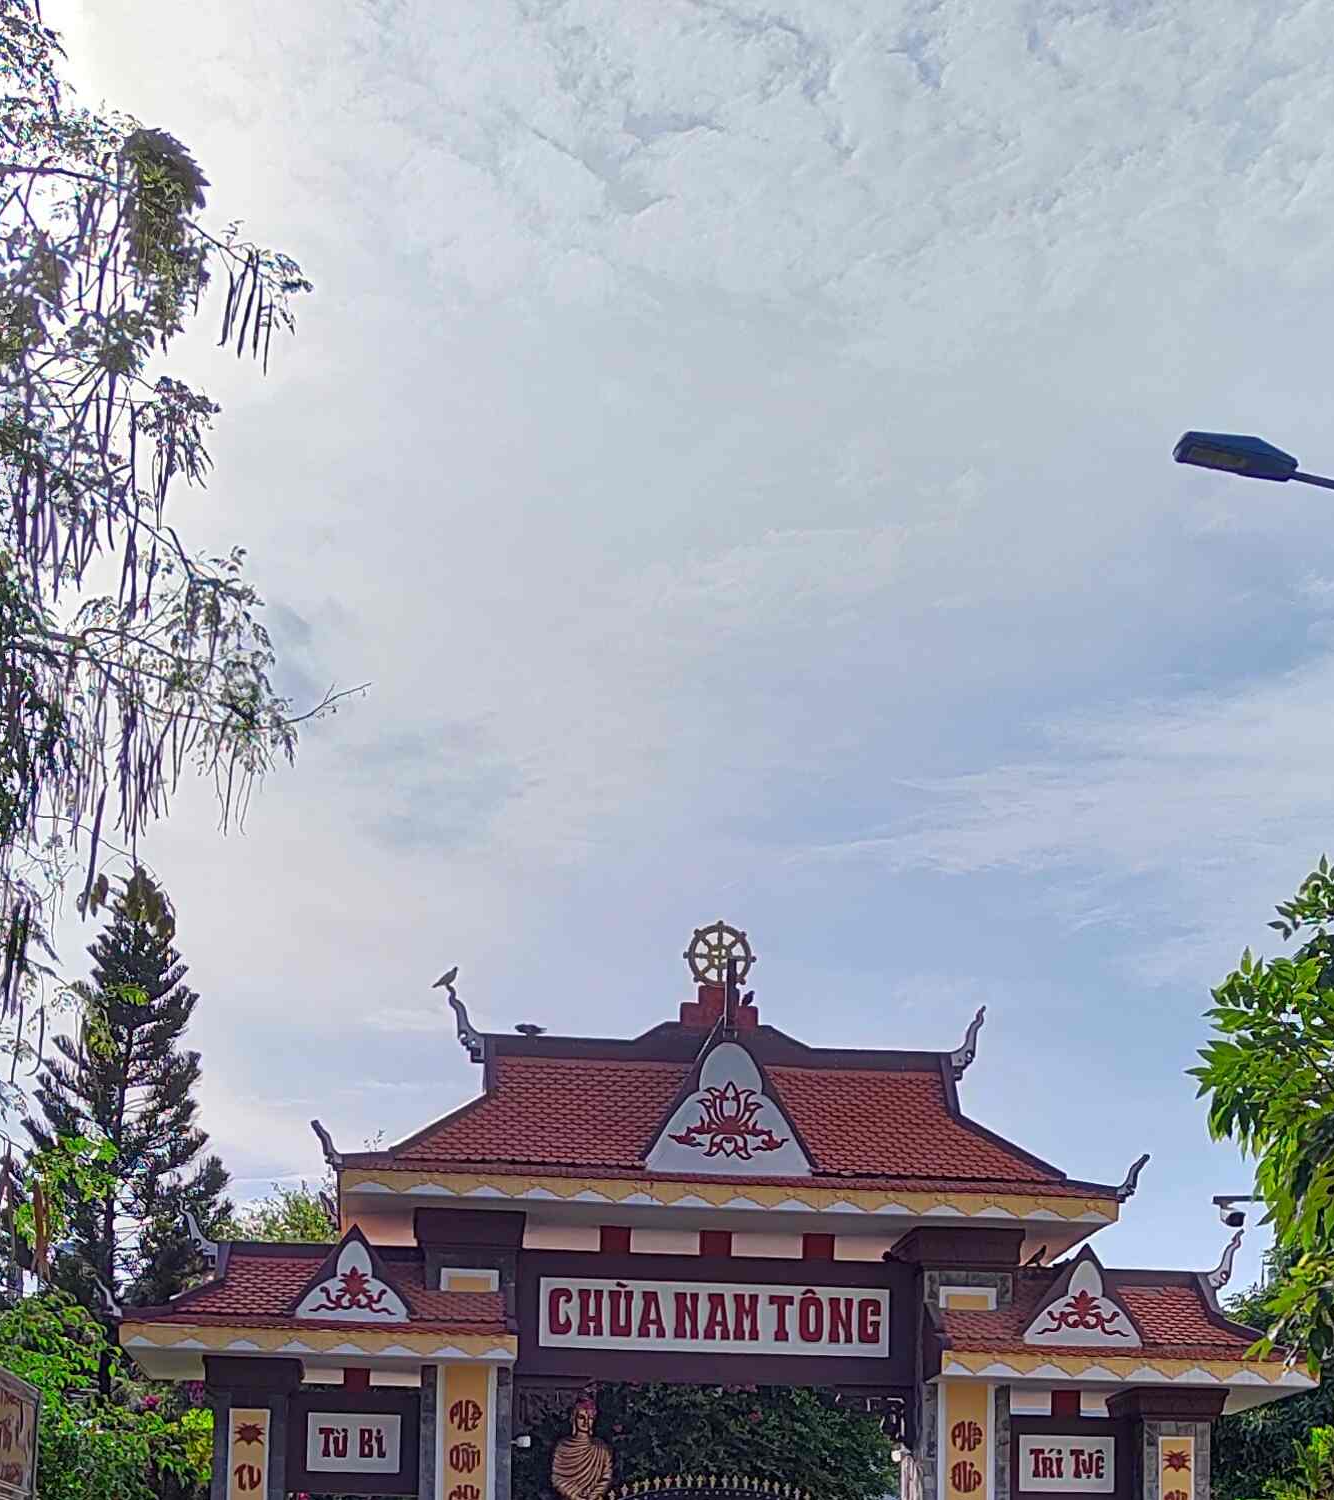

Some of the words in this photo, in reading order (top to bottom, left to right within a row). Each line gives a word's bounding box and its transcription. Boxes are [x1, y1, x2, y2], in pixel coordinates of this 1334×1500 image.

[547, 1281, 666, 1337] CHÙA
[673, 1292, 760, 1342] NAM
[768, 1288, 882, 1344] TÔNG
